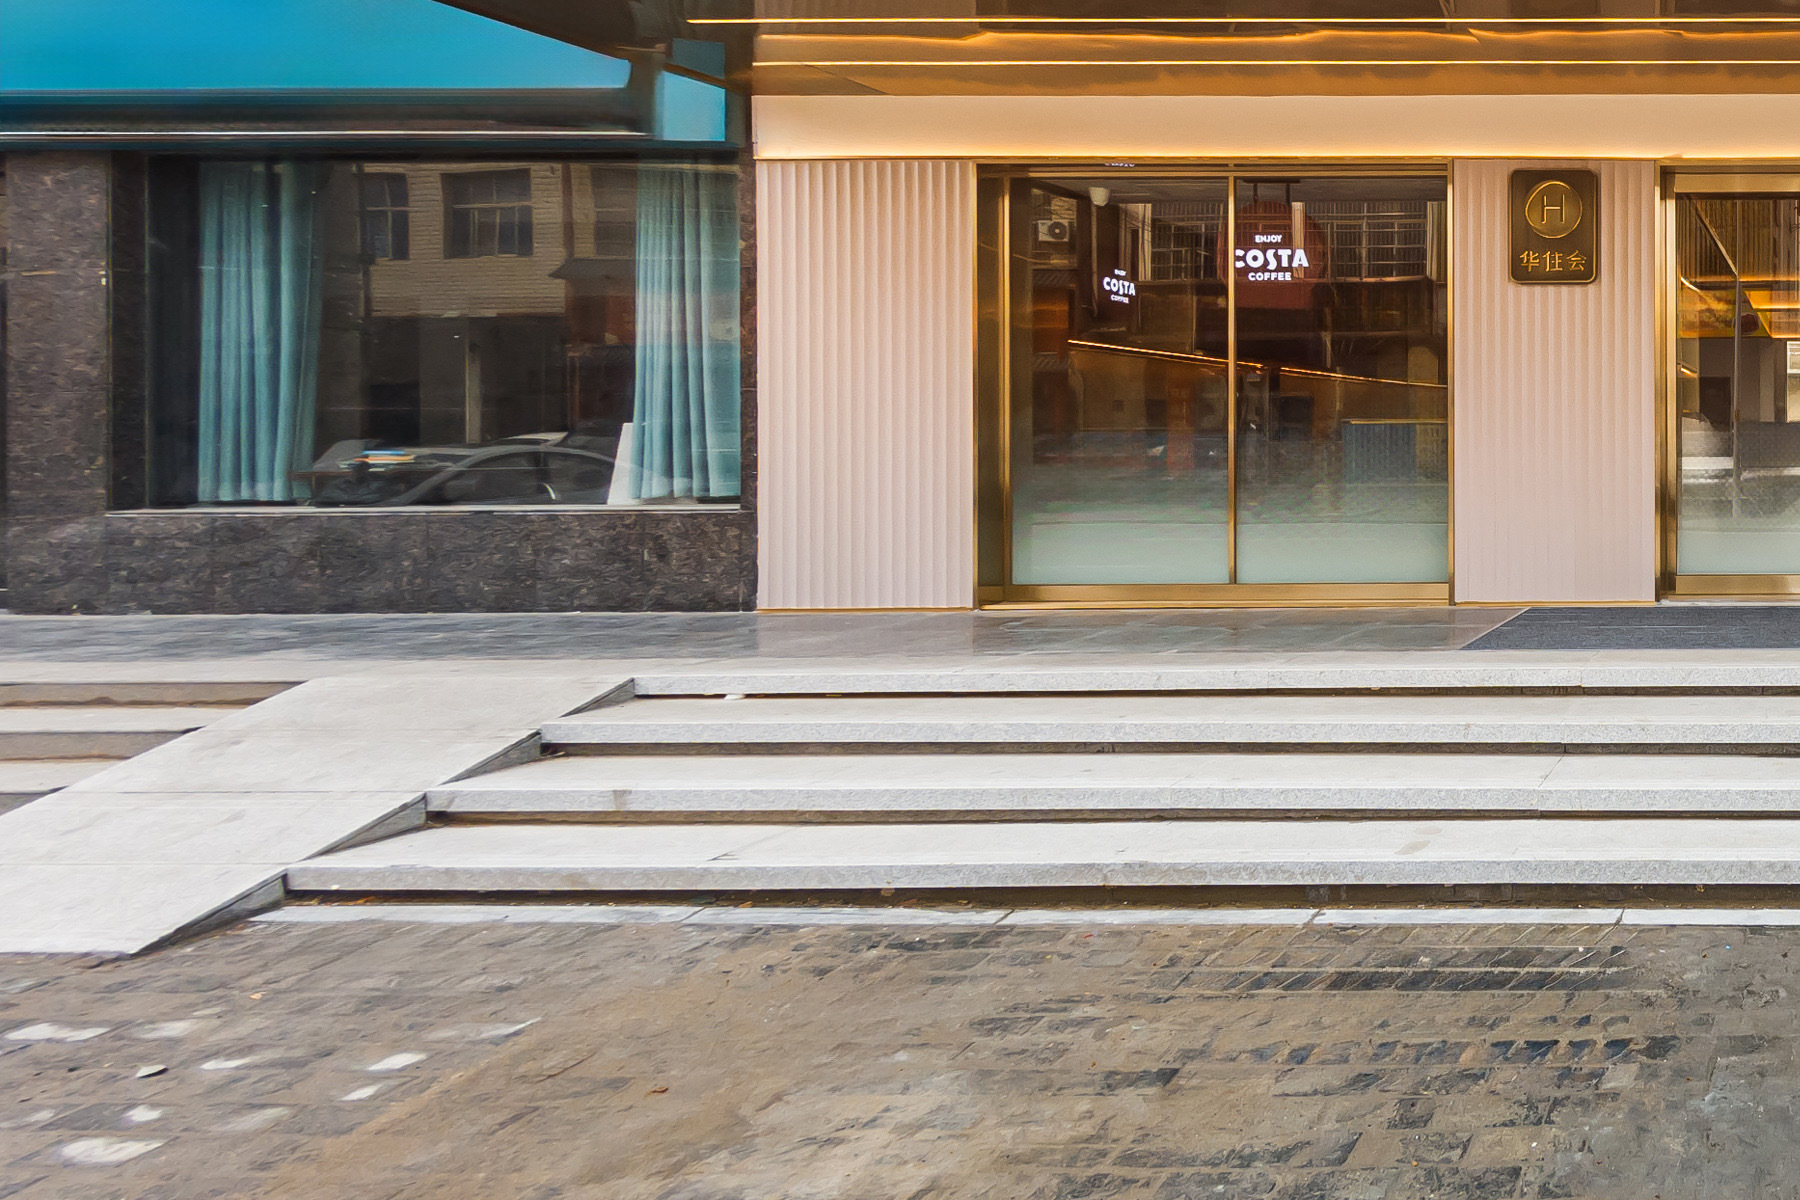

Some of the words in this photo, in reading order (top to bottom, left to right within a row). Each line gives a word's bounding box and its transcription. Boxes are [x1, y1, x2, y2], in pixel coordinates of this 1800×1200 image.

[1541, 194, 1565, 224] H
[1254, 234, 1283, 243] ENJOY
[1519, 250, 1587, 272] 华住会
[1103, 276, 1136, 296] COSTA
[1248, 271, 1292, 281] COFFEE
